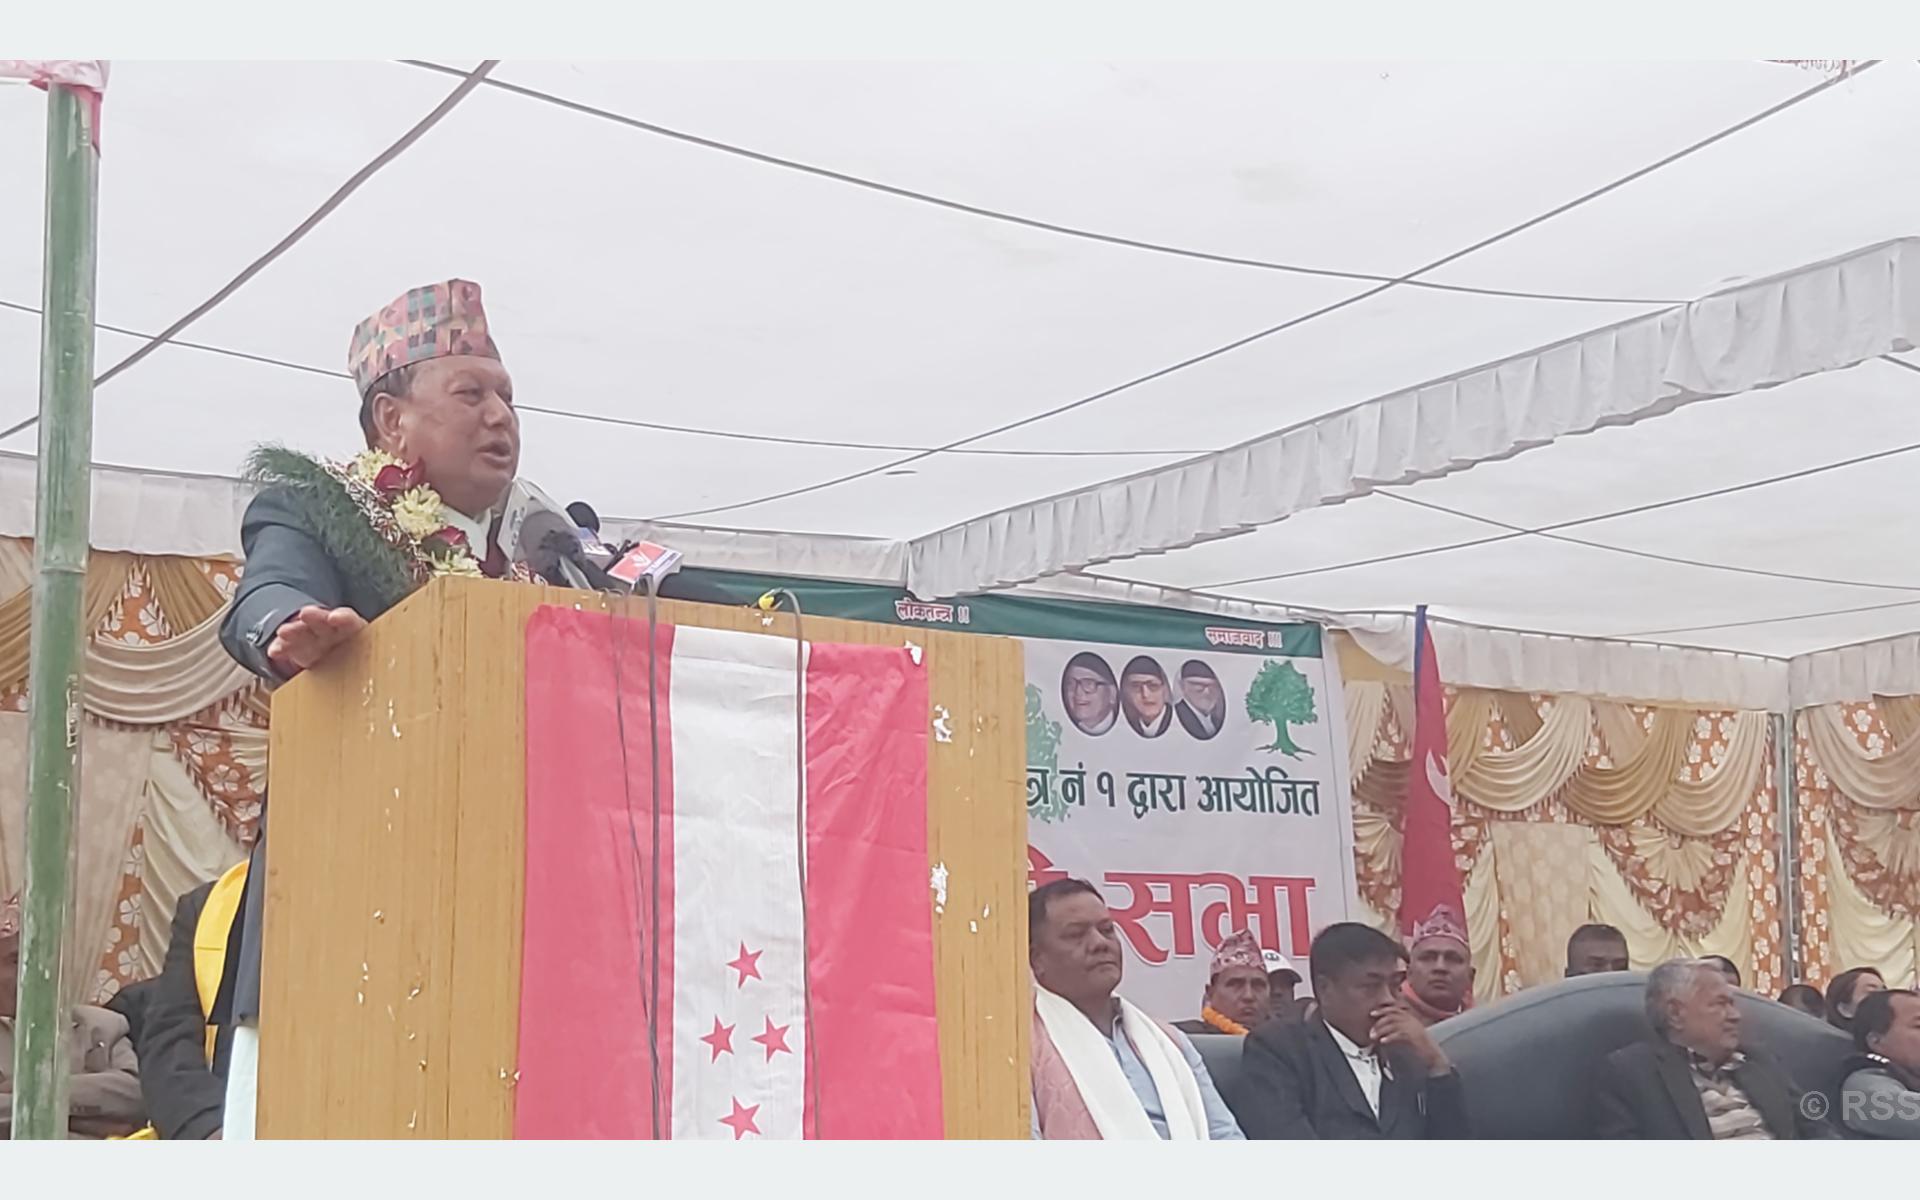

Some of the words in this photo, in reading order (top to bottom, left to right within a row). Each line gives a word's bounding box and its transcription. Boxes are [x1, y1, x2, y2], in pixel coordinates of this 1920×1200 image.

[895, 597, 953, 622] लोकतन्त्र
[1205, 627, 1264, 649] समाजवाद
[1027, 767, 1050, 806] त्र
[1059, 761, 1087, 806] नं
[1097, 771, 1115, 807] १
[1126, 772, 1187, 819] द्वारा
[1195, 766, 1320, 816] आयोजित
[1104, 872, 1315, 963] सभा
